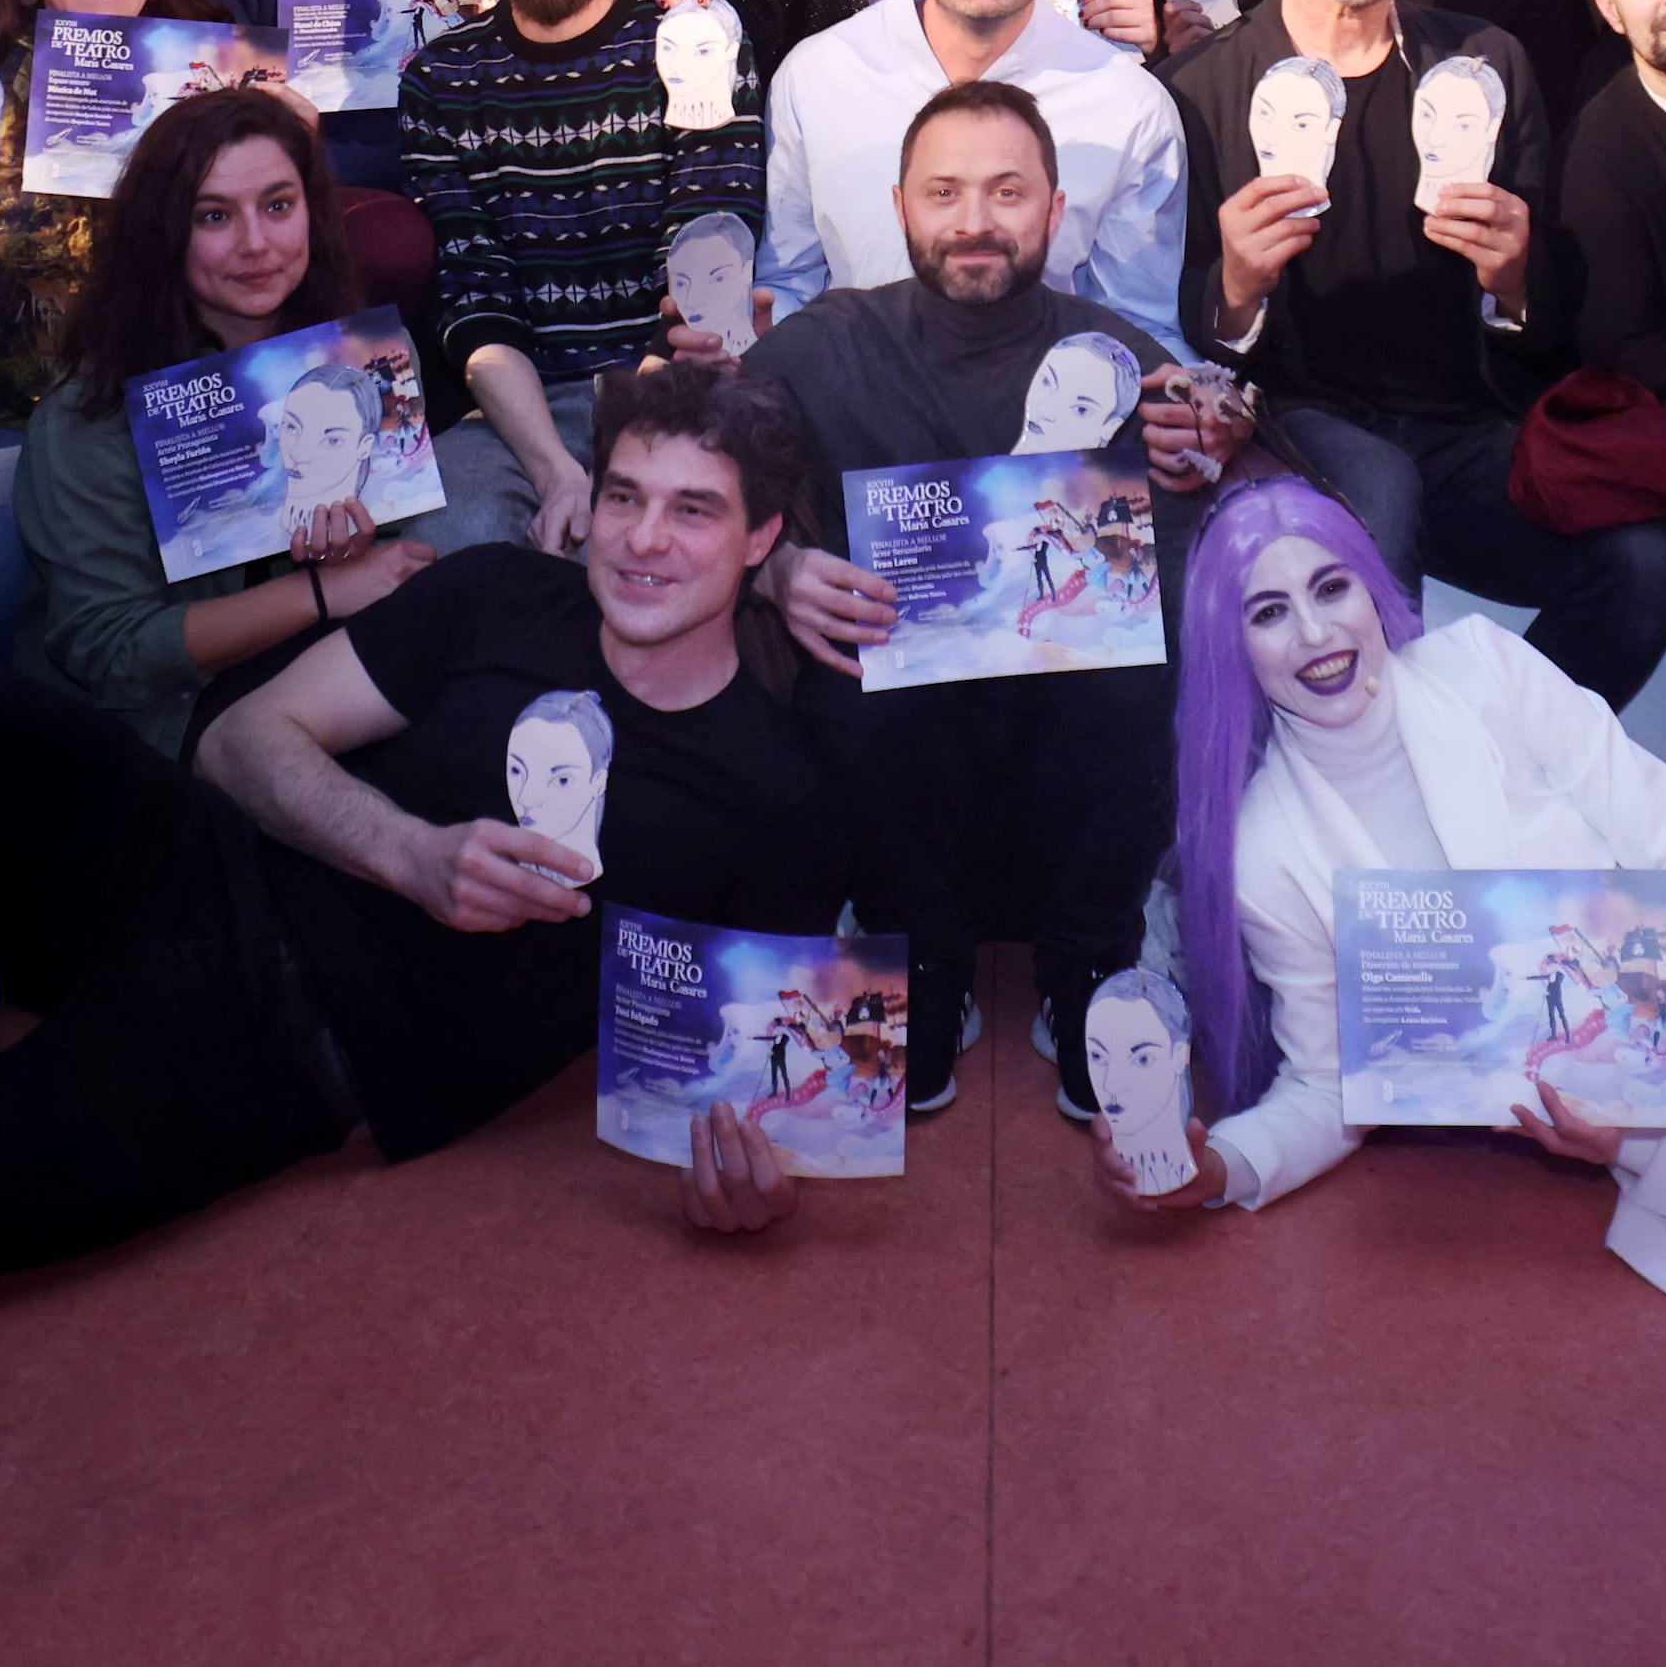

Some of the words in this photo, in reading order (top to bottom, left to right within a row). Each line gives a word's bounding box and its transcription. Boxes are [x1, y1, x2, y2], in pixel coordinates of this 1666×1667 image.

[52, 26, 123, 45] PREMIOS
[63, 41, 131, 60] TEATRO
[144, 373, 223, 408] PREMIOS
[161, 386, 236, 420] TEATRO
[178, 412, 207, 428] María
[867, 480, 951, 506] PREMIOS
[882, 496, 963, 522] TEATRO
[900, 519, 930, 533] María
[1359, 891, 1454, 910] PREMIOS
[1375, 910, 1467, 930] TEATRO
[617, 928, 692, 963] PREMIOS
[1394, 931, 1427, 943] María
[629, 951, 703, 984] TEATRO
